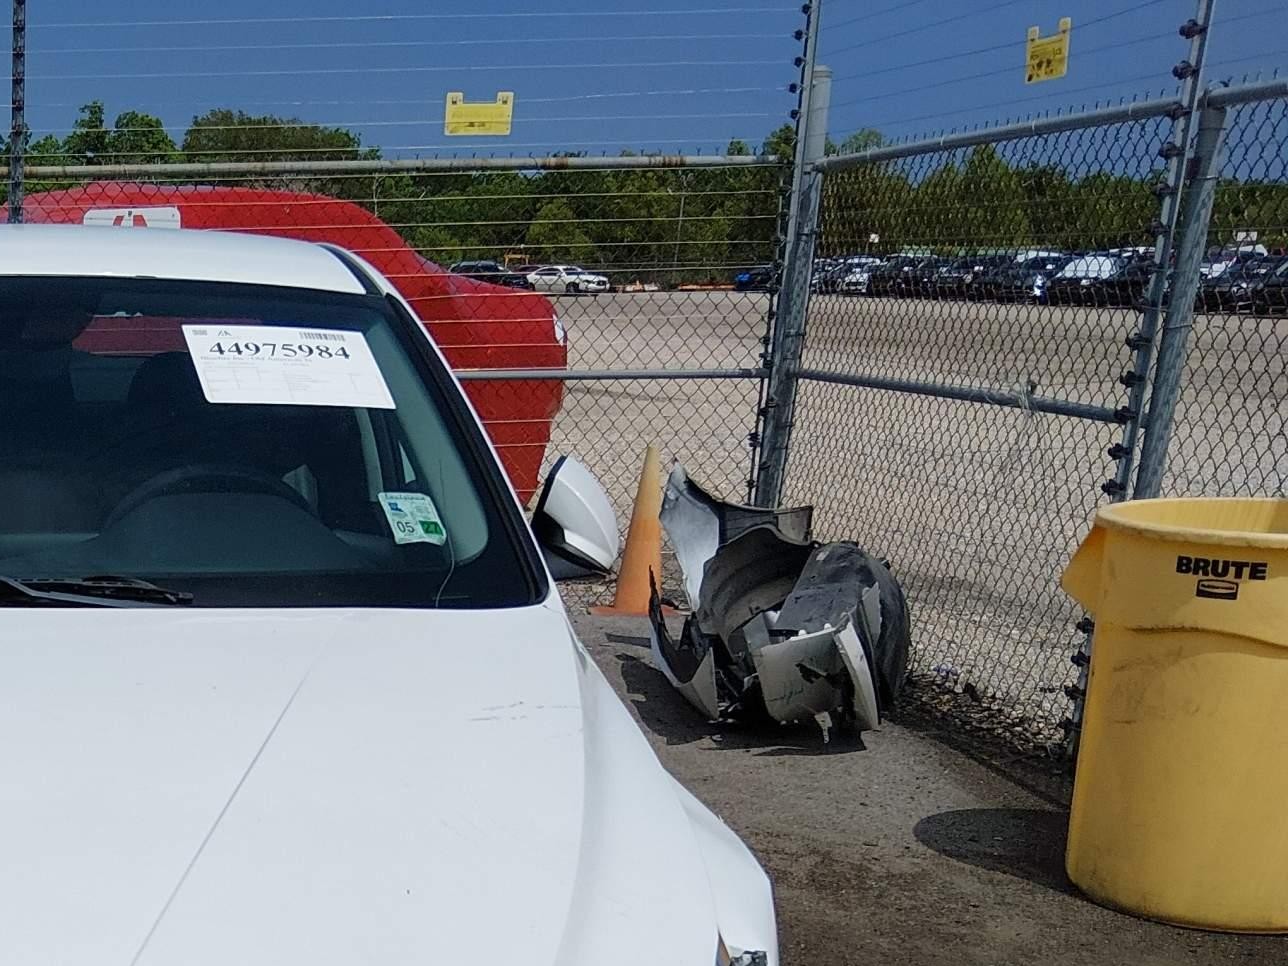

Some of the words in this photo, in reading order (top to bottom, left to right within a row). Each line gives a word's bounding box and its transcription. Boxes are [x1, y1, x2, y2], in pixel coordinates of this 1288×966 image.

[209, 341, 350, 360] 44975984
[396, 521, 415, 533] 05
[1176, 555, 1268, 580] BRUTE
